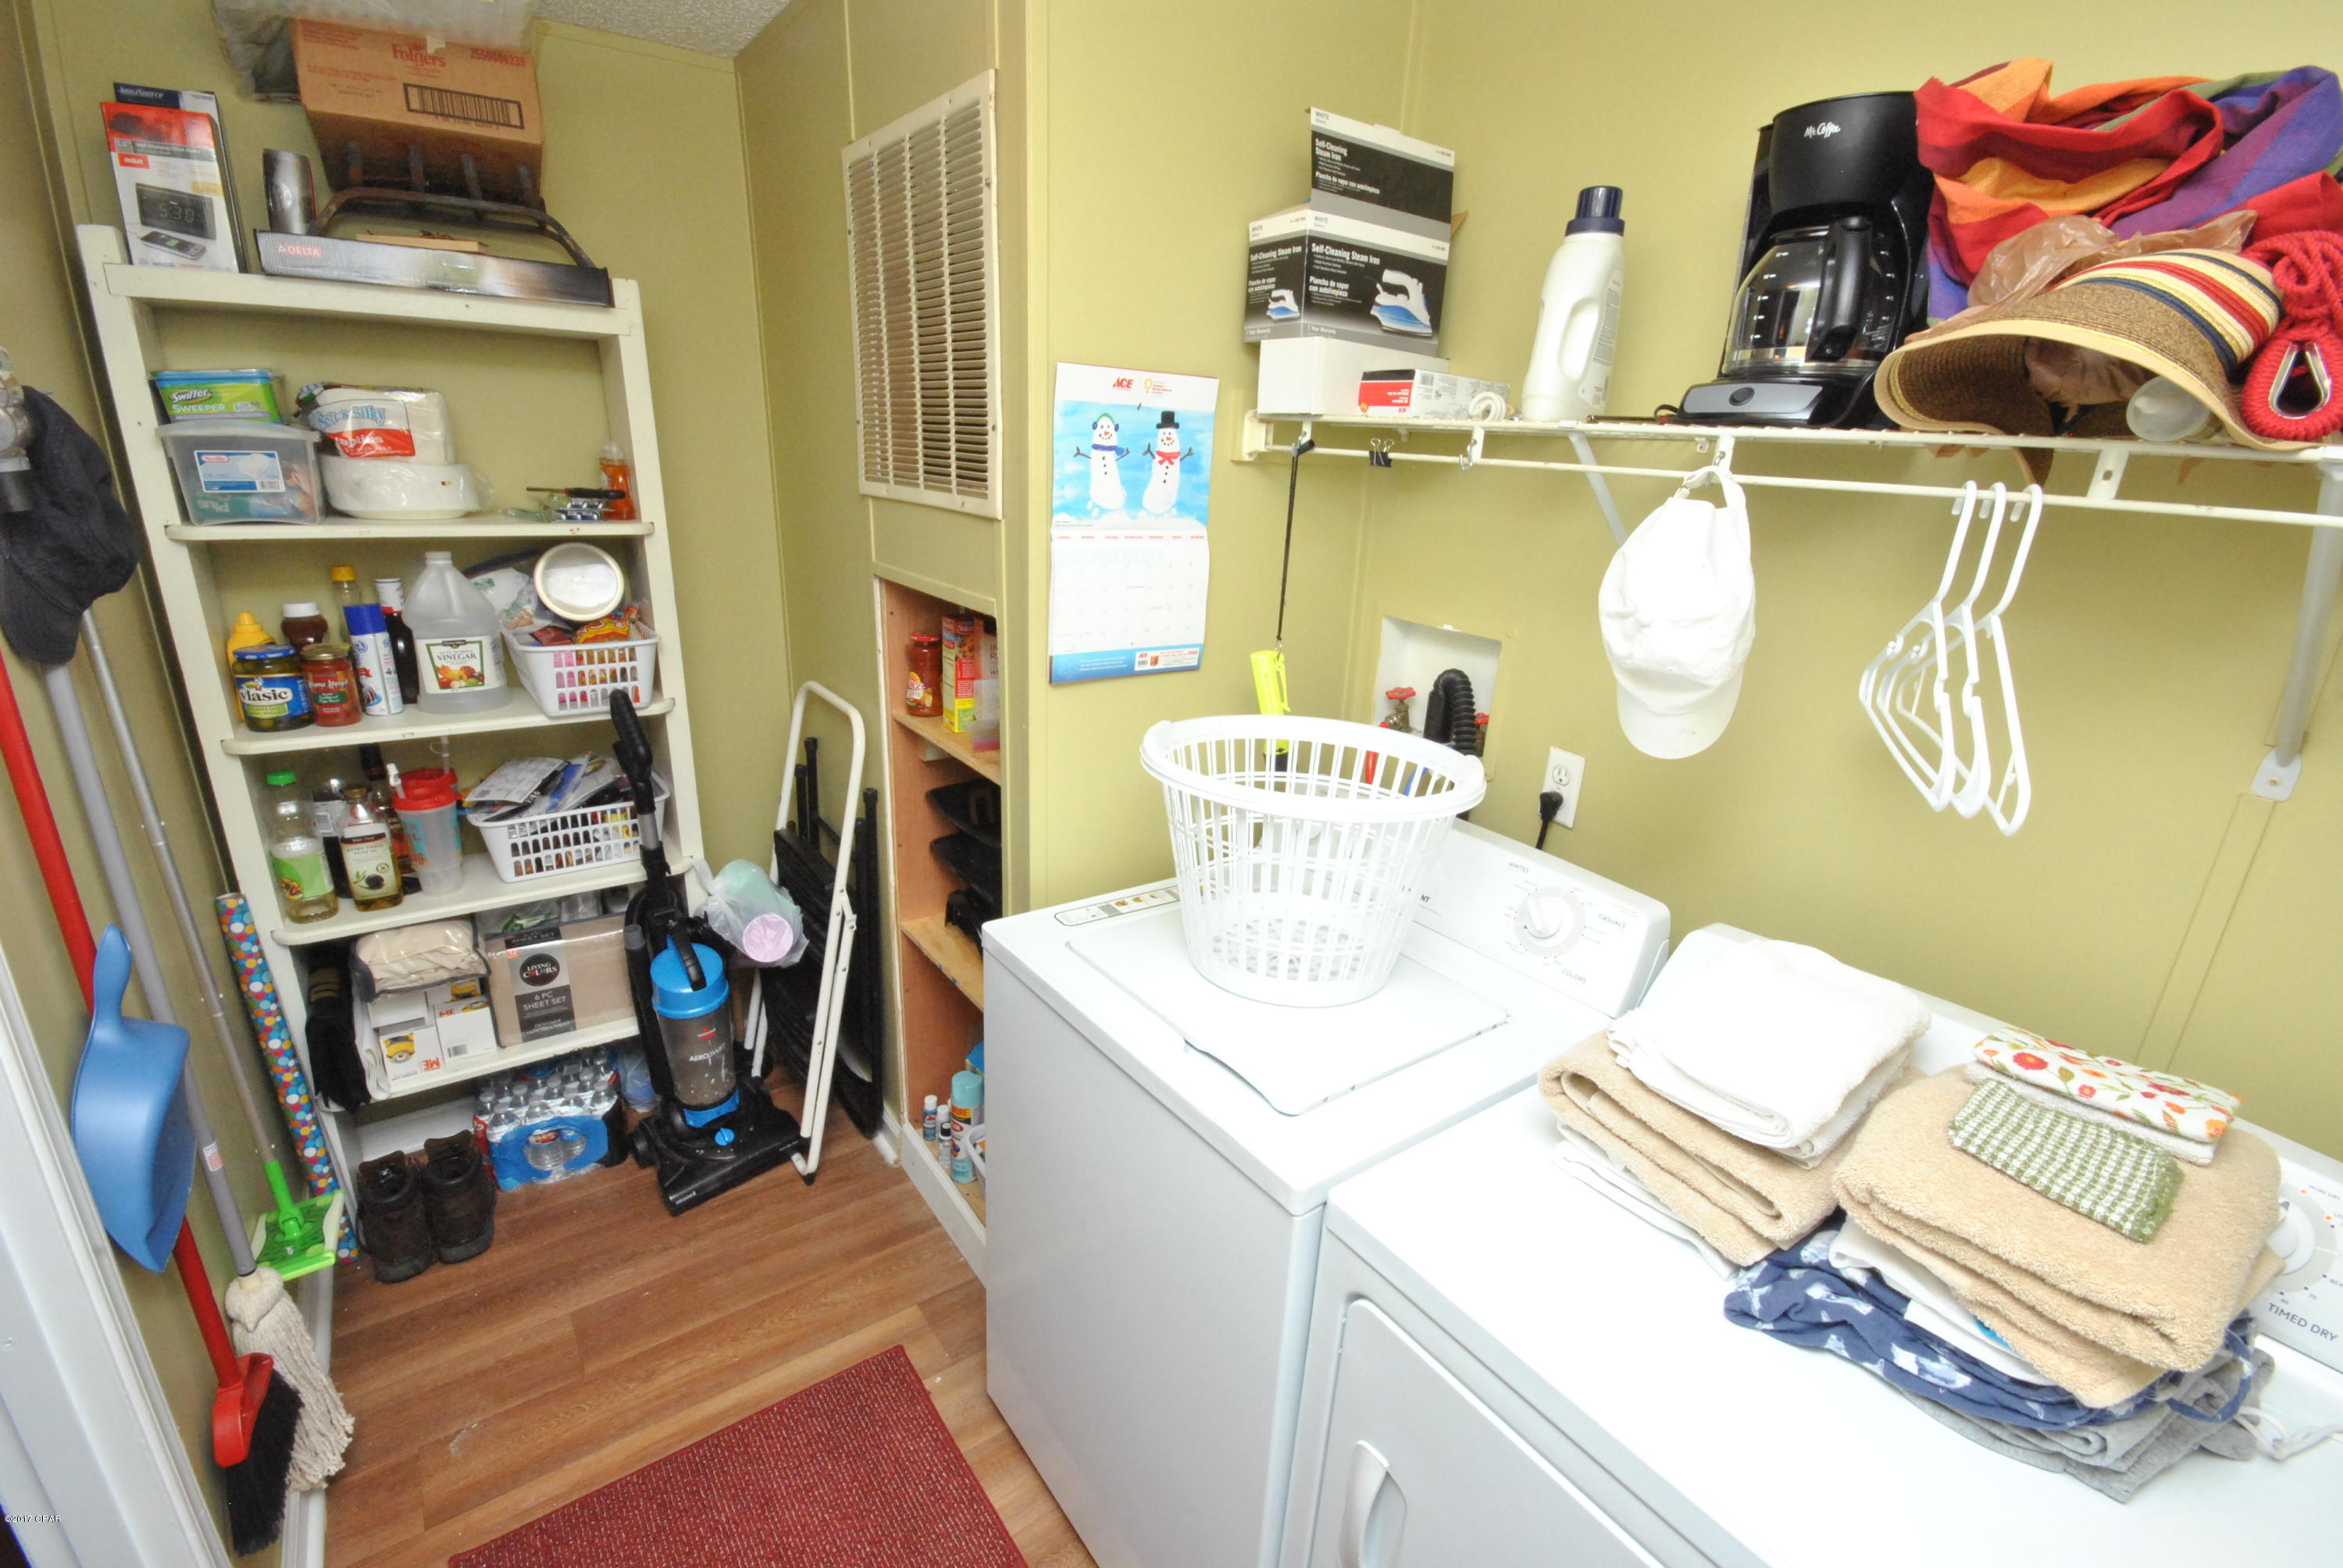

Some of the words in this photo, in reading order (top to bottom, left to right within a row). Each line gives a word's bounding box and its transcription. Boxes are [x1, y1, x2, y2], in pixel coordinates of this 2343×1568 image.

[391, 43, 446, 68] Folgers
[1817, 122, 1841, 139] Coffee
[1315, 138, 1348, 157] Self-Cleaning
[1315, 146, 1331, 159] Steam
[1331, 151, 1342, 162] Iron
[287, 246, 321, 256] DELTA
[1278, 247, 1292, 256] Steam
[1292, 245, 1303, 254] Iron
[1312, 243, 1350, 260] Self-Cleaning
[1351, 251, 1368, 262] Steam
[1369, 254, 1380, 265] Iron
[1310, 276, 1328, 287] Plancha
[1336, 282, 1350, 290] vapor
[1112, 376, 1134, 389] ACE
[171, 388, 209, 403] Swiffer
[172, 404, 226, 413] SWEEPER
[353, 405, 386, 426] Silky
[437, 653, 477, 661] VINEGAR
[1509, 861, 1529, 874] WHITES
[1598, 913, 1627, 929] CASUALS
[523, 966, 558, 978] COLORS
[526, 962, 551, 971] LIVING
[1562, 968, 1588, 984] COLORS
[522, 1000, 548, 1011] SHEET
[551, 996, 567, 1004] SET
[439, 1008, 456, 1018] ME
[2309, 1184, 2327, 1196] MORE
[2327, 1192, 2341, 1201] DRY
[2268, 1302, 2308, 1328] TIMED
[2309, 1323, 2338, 1342] DRY
